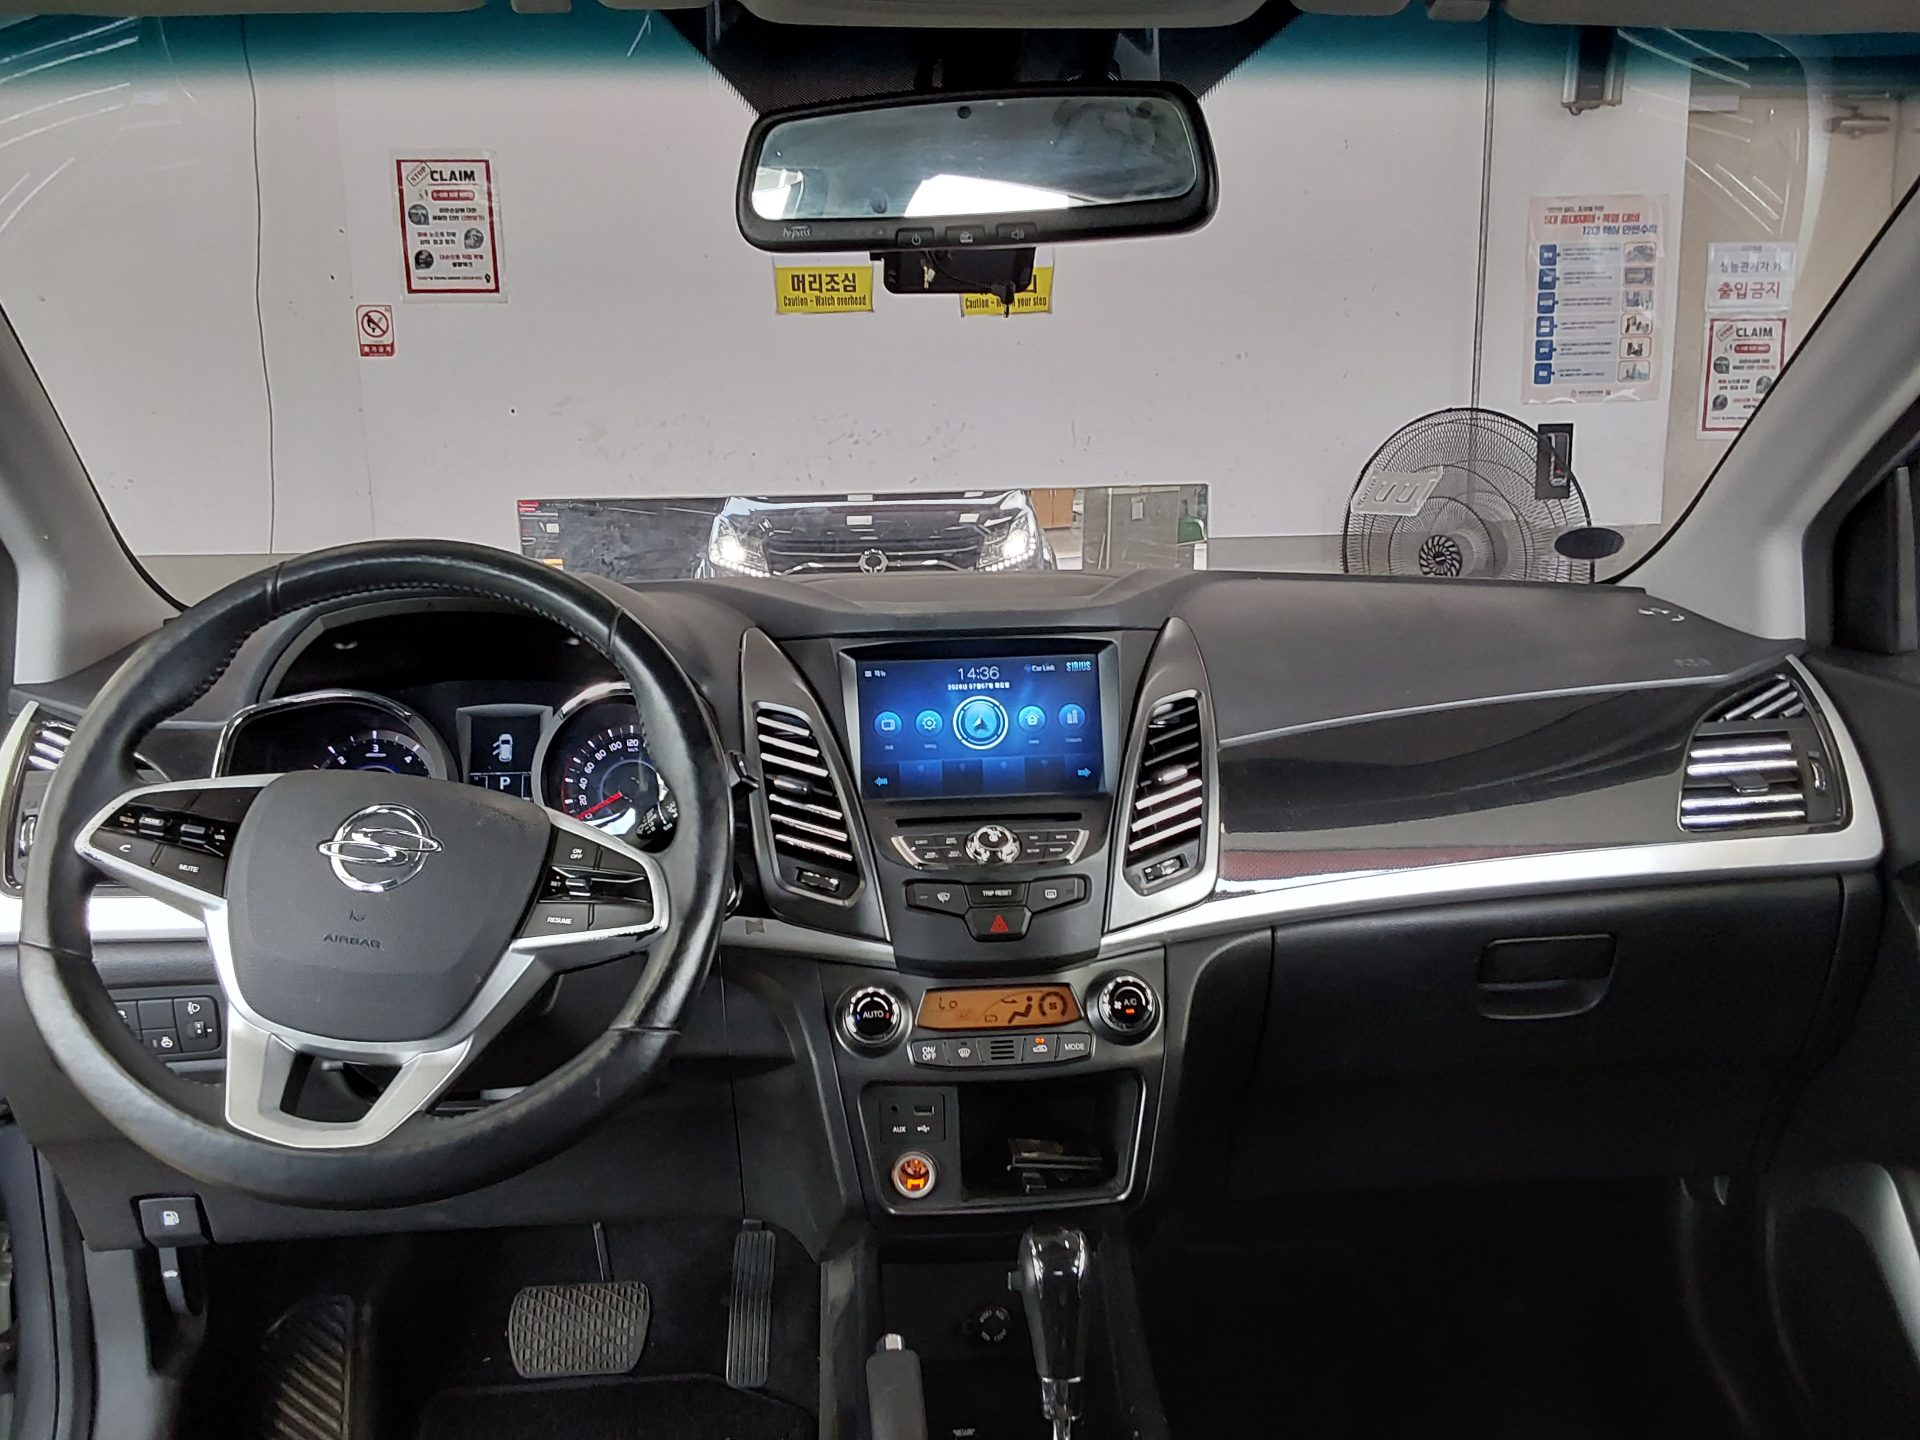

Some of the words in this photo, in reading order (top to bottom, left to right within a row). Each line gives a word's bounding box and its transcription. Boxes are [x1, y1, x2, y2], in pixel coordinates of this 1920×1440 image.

[430, 170, 475, 181] CLAIM
[791, 273, 857, 293] 머리조심
[1718, 282, 1780, 299] 출입금지
[784, 295, 808, 307] Caution
[815, 294, 835, 307] Watch
[837, 295, 866, 306] overhead
[965, 298, 989, 309] Caution
[1018, 297, 1031, 307] your
[1033, 297, 1046, 306] step
[1736, 327, 1773, 337] CLAIM
[958, 666, 999, 680] 14:36
[372, 744, 379, 752] 3
[609, 741, 622, 751] 100
[627, 739, 639, 747] 120
[595, 749, 607, 760] 80
[337, 756, 347, 765] 2
[584, 762, 595, 774] 60
[500, 776, 511, 790] P
[579, 778, 588, 790] 40
[578, 794, 588, 806] 20
[179, 864, 199, 873] MUTE
[323, 934, 381, 948] AIRBAG
[863, 1010, 884, 1018] AUTO
[1064, 1043, 1085, 1051] MODE
[922, 1053, 937, 1061] OFF
